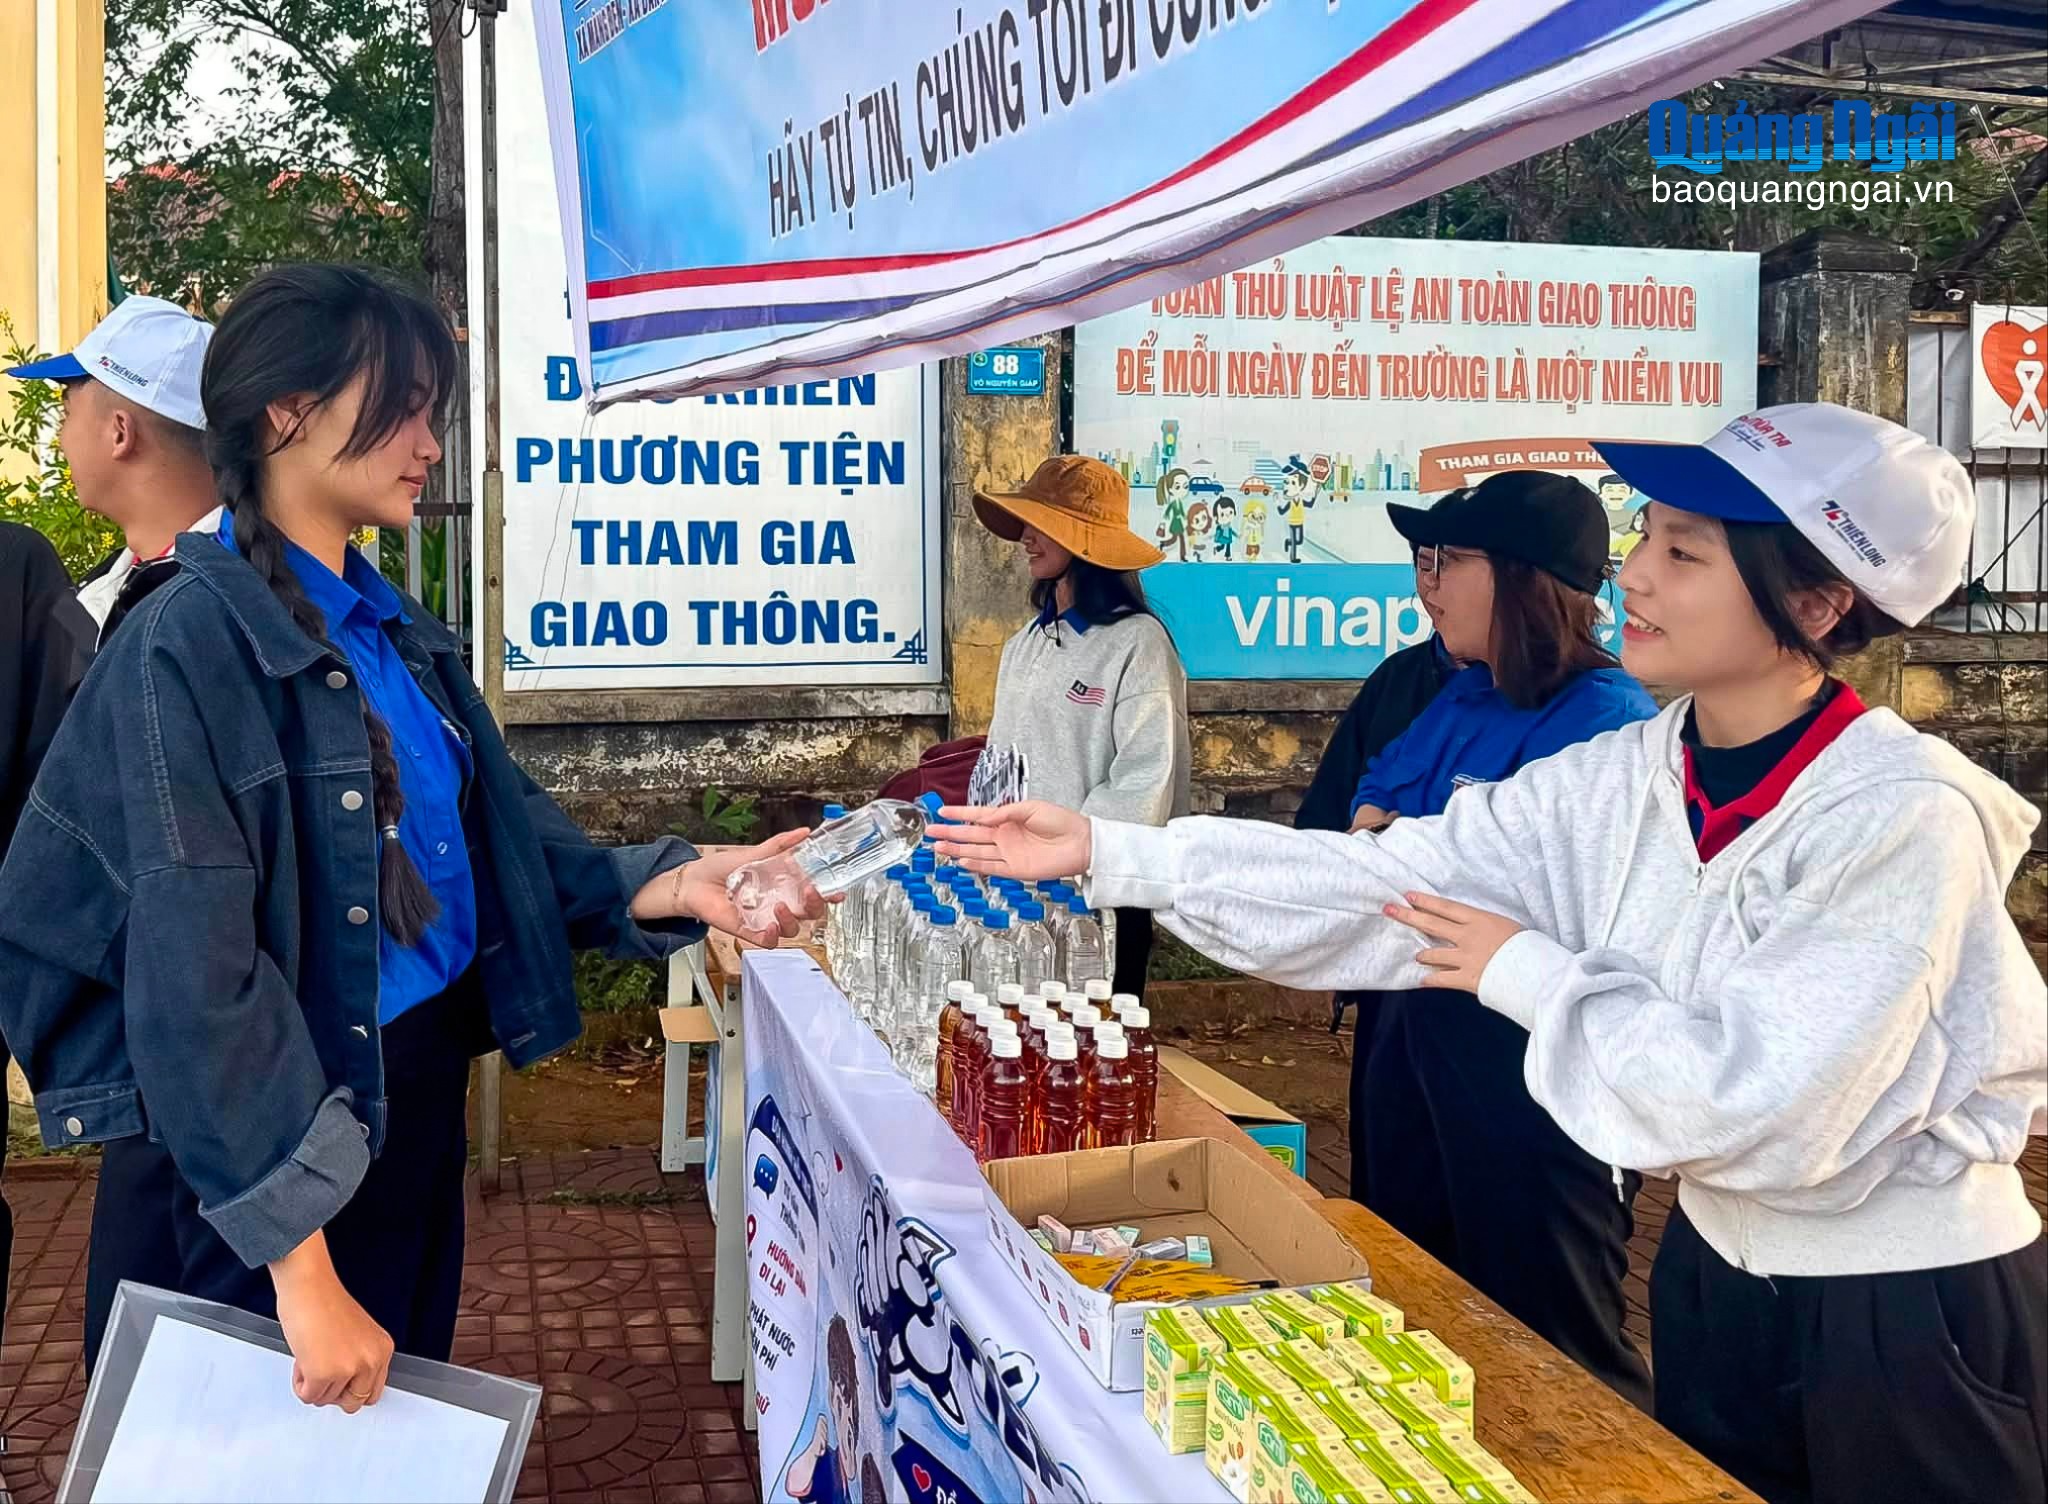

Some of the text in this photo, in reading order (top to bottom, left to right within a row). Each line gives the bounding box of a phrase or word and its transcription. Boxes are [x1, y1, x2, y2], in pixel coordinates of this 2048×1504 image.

[767, 117, 816, 238] HÃY
[820, 92, 856, 230] TỰ
[857, 81, 914, 201] TIN,
[916, 7, 1025, 172] CHÚNG
[1232, 257, 1289, 321] THỦ
[1294, 265, 1365, 332] LUẬT
[1371, 267, 1406, 333] LỆ
[1411, 276, 1450, 322] AN
[1458, 270, 1532, 325] TOÀN
[1537, 279, 1602, 327] GIAO
[1608, 275, 1697, 330] THÔNG
[993, 354, 1019, 375] 88
[1115, 330, 1724, 413] ĐỂ MỖI NGÀY ĐẾN TRƯỜNG LÀ MỘT NIỀM VUI
[516, 431, 905, 496] PHƯƠNG TIỆN
[1436, 453, 1490, 470] THAM
[1494, 451, 1525, 465] GIA
[1528, 450, 1570, 463] GIAO
[572, 519, 856, 566] THAM GIA
[530, 590, 896, 647] GIAO THÔNG.
[770, 1272, 787, 1297] LẠI
[759, 1345, 779, 1372] PHÍ
[768, 1322, 796, 1357] NƯỚC
